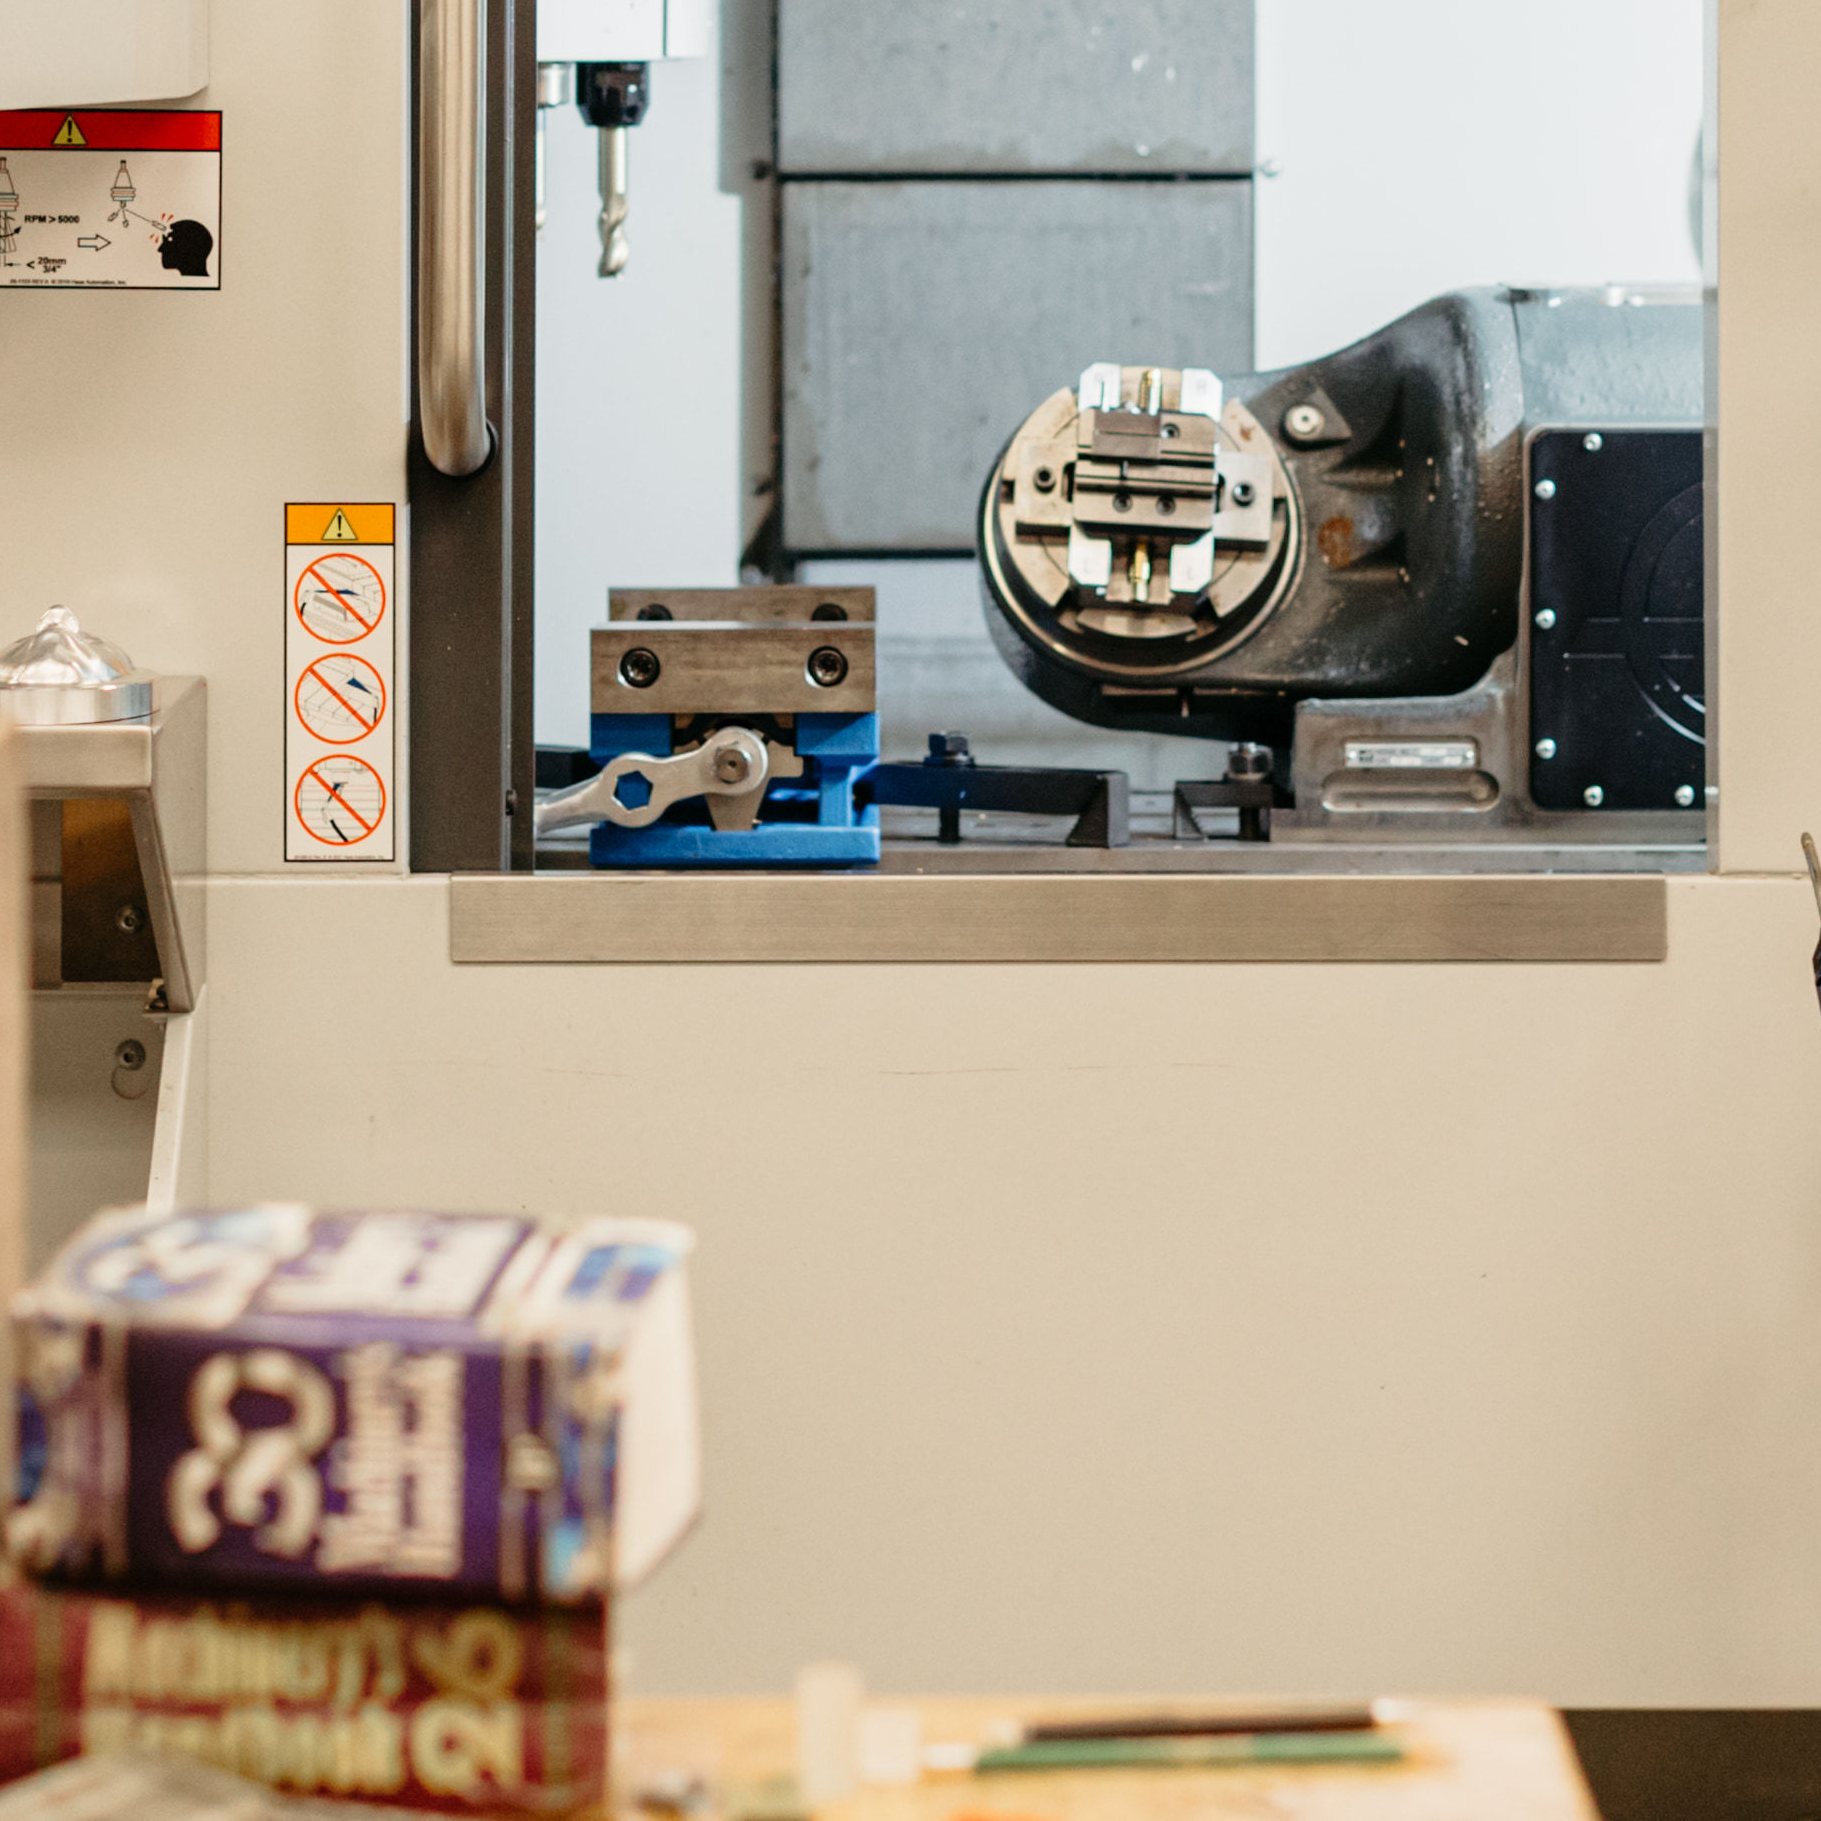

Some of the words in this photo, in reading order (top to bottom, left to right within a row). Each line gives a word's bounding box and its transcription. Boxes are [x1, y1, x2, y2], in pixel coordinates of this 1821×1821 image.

[24, 214, 47, 223] RPM
[58, 215, 80, 224] 5000
[38, 257, 66, 265] 20mm
